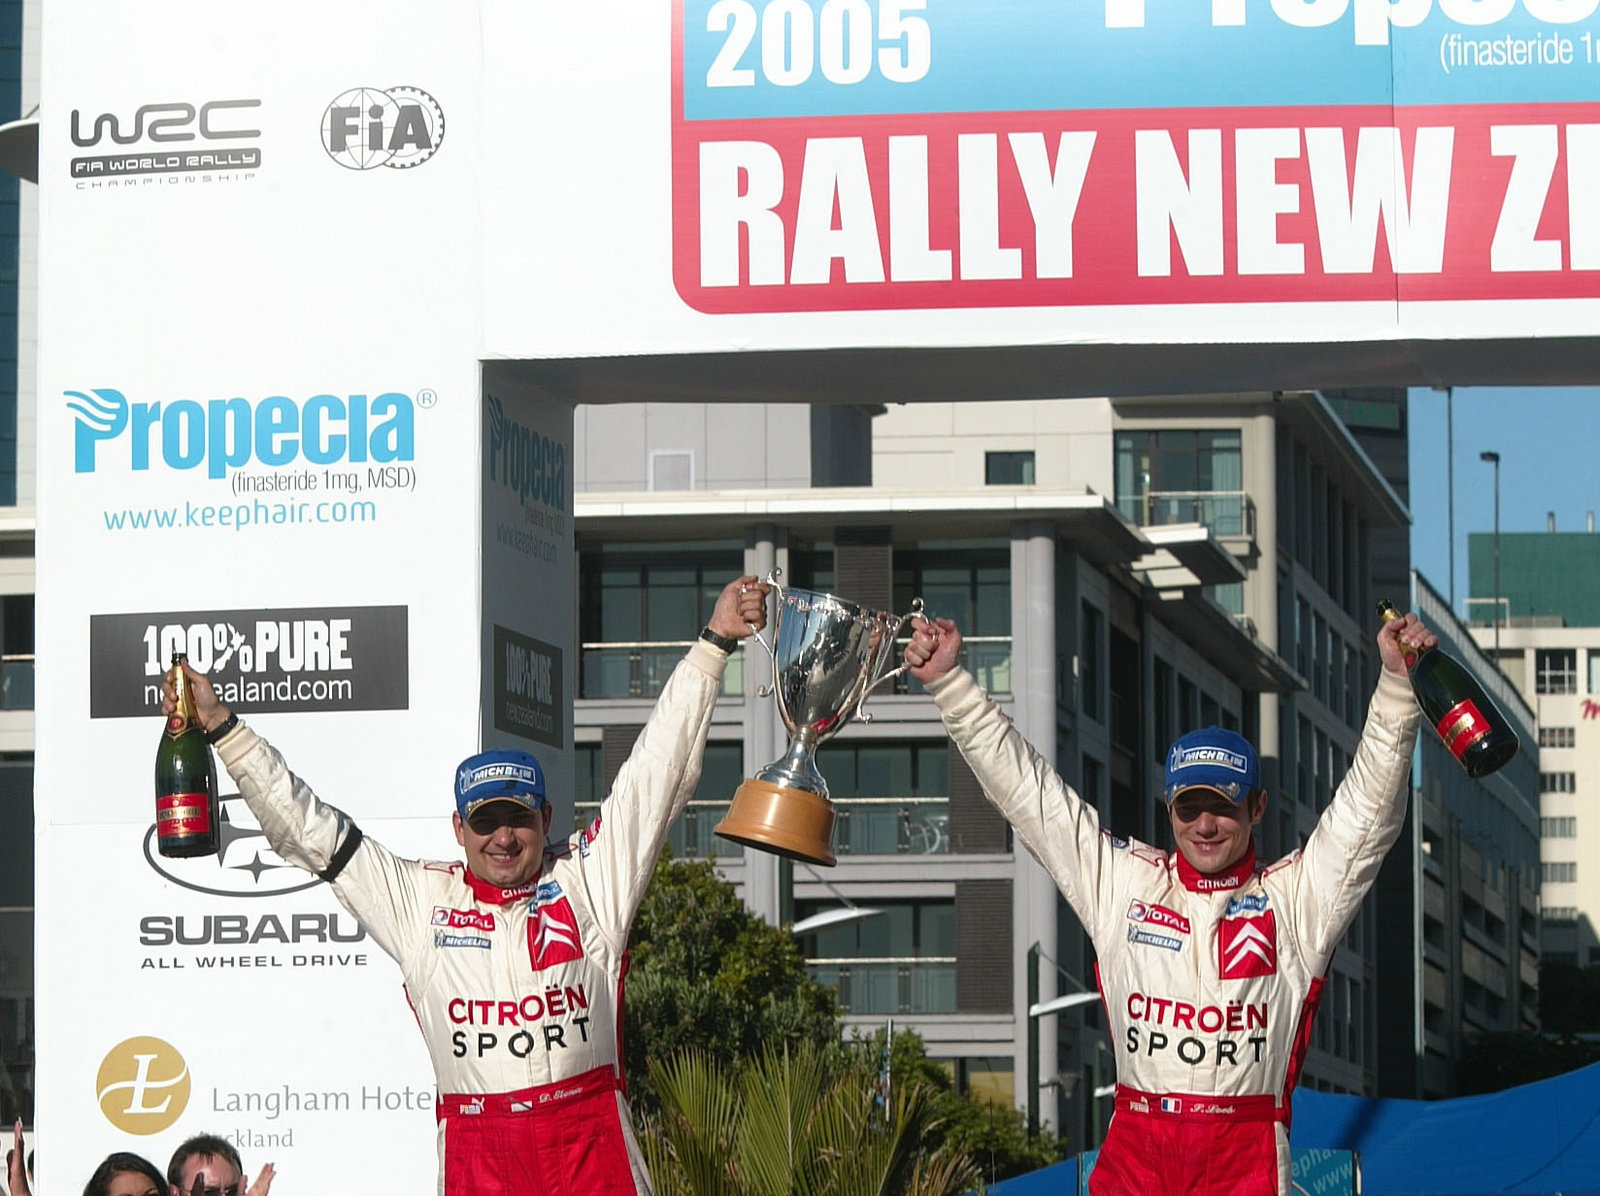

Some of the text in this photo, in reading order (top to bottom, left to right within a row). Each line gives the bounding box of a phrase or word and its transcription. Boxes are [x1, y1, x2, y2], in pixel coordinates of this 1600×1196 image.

[706, 0, 932, 88] 2005
[1440, 32, 1574, 73] (finasteride
[71, 99, 262, 147] WRC
[75, 152, 256, 173] FIA WORLD RALLY
[75, 172, 256, 190] CHAMPIONSHIP
[699, 131, 1098, 287] RALLY
[1134, 125, 1456, 277] NEW
[231, 466, 417, 497] (finasteride 1mg, MSD)
[104, 496, 377, 532] www.keephair.com
[143, 618, 353, 676] 100% PURE
[139, 913, 367, 946] SUBARU
[452, 911, 494, 930] TOTAL
[1147, 907, 1190, 933] TOTAL
[445, 935, 491, 948] MICHELIN
[1136, 931, 1181, 949] MICHELIN
[141, 954, 368, 970] ALL WHEEL DRIVE
[448, 983, 588, 1026] CITROËN
[1127, 992, 1268, 1034] CITROËN
[452, 1016, 589, 1058] SPORT
[1126, 1026, 1267, 1066] SPORT
[212, 1084, 438, 1120] Langham Hote
[222, 1129, 294, 1148] ckland
